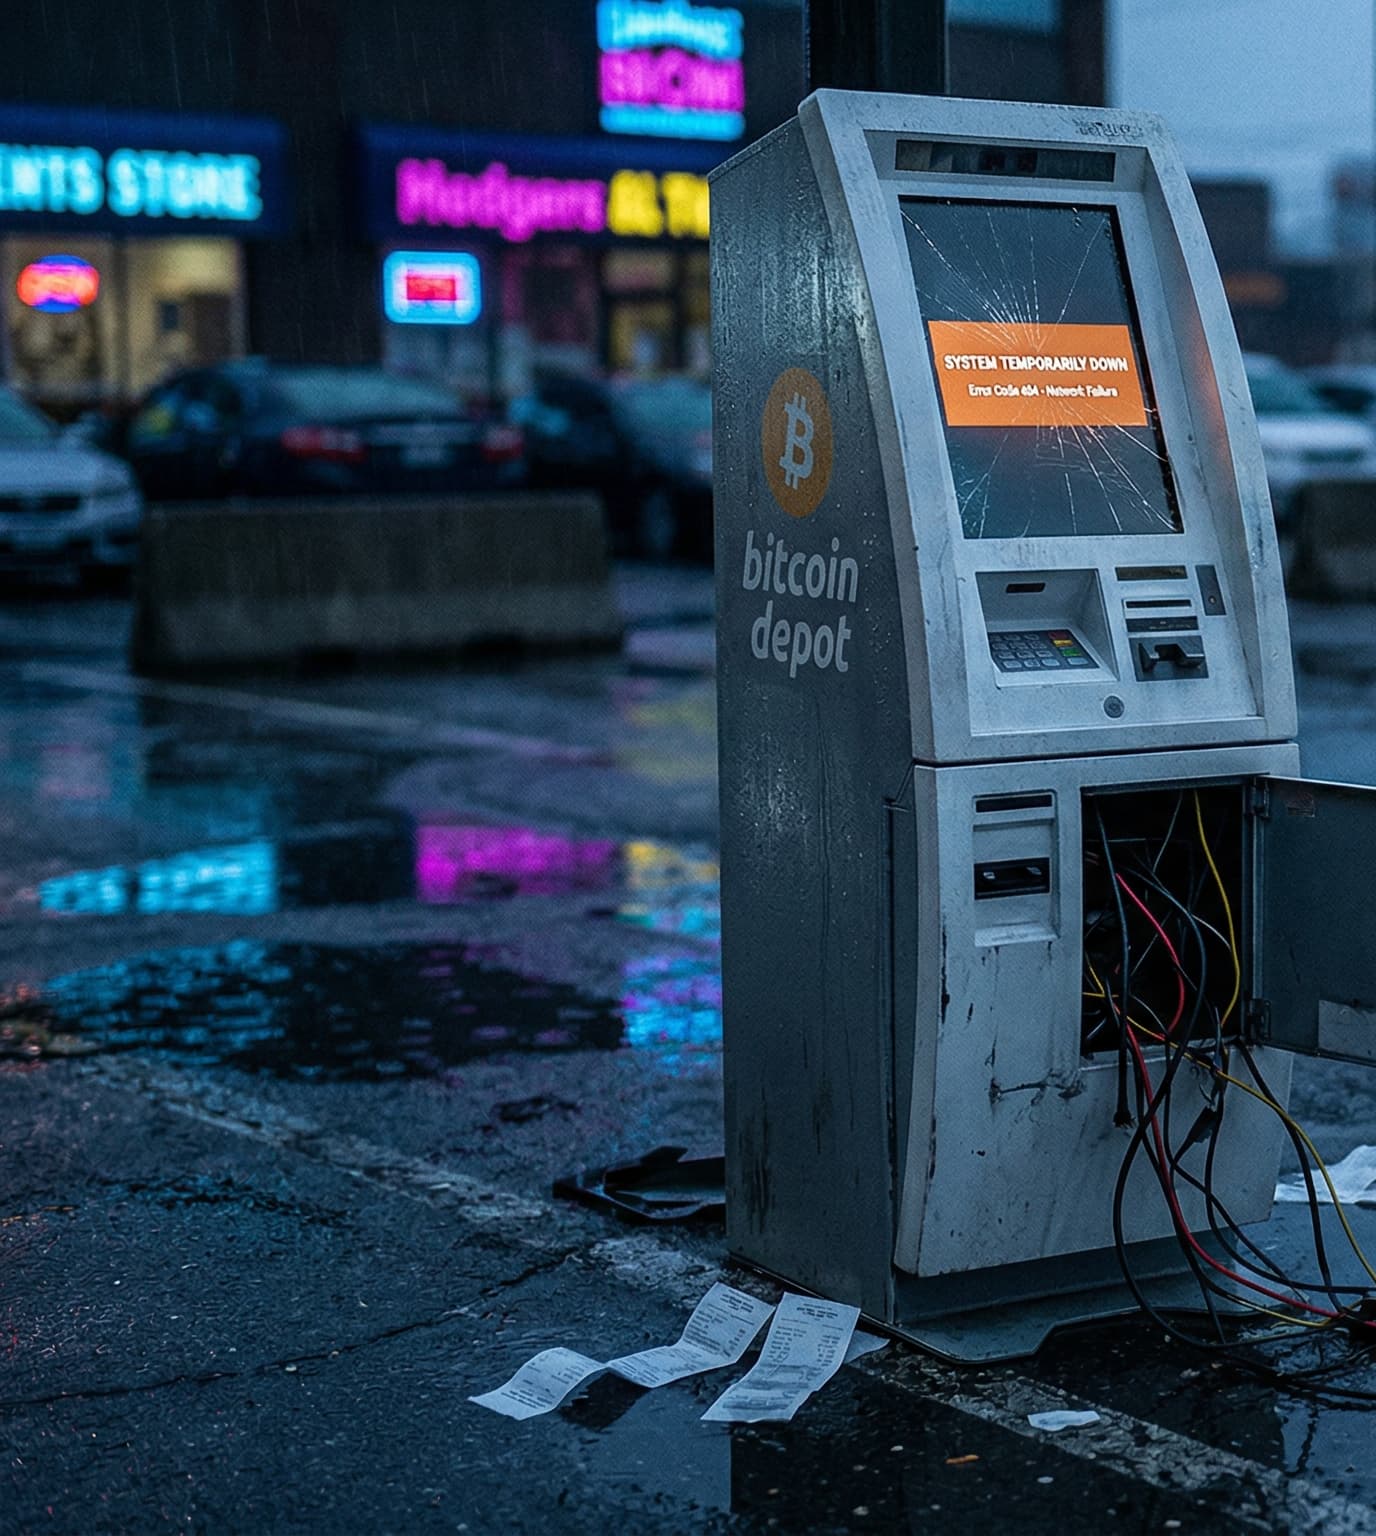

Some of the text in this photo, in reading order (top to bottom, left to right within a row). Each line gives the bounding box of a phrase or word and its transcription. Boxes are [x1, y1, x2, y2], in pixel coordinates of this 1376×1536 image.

[107, 148, 263, 220] STORE
[944, 355, 1128, 372] SYSTEM TEMPORARILY DOWN
[742, 530, 858, 602] bitcoin
[751, 599, 851, 679] depot
